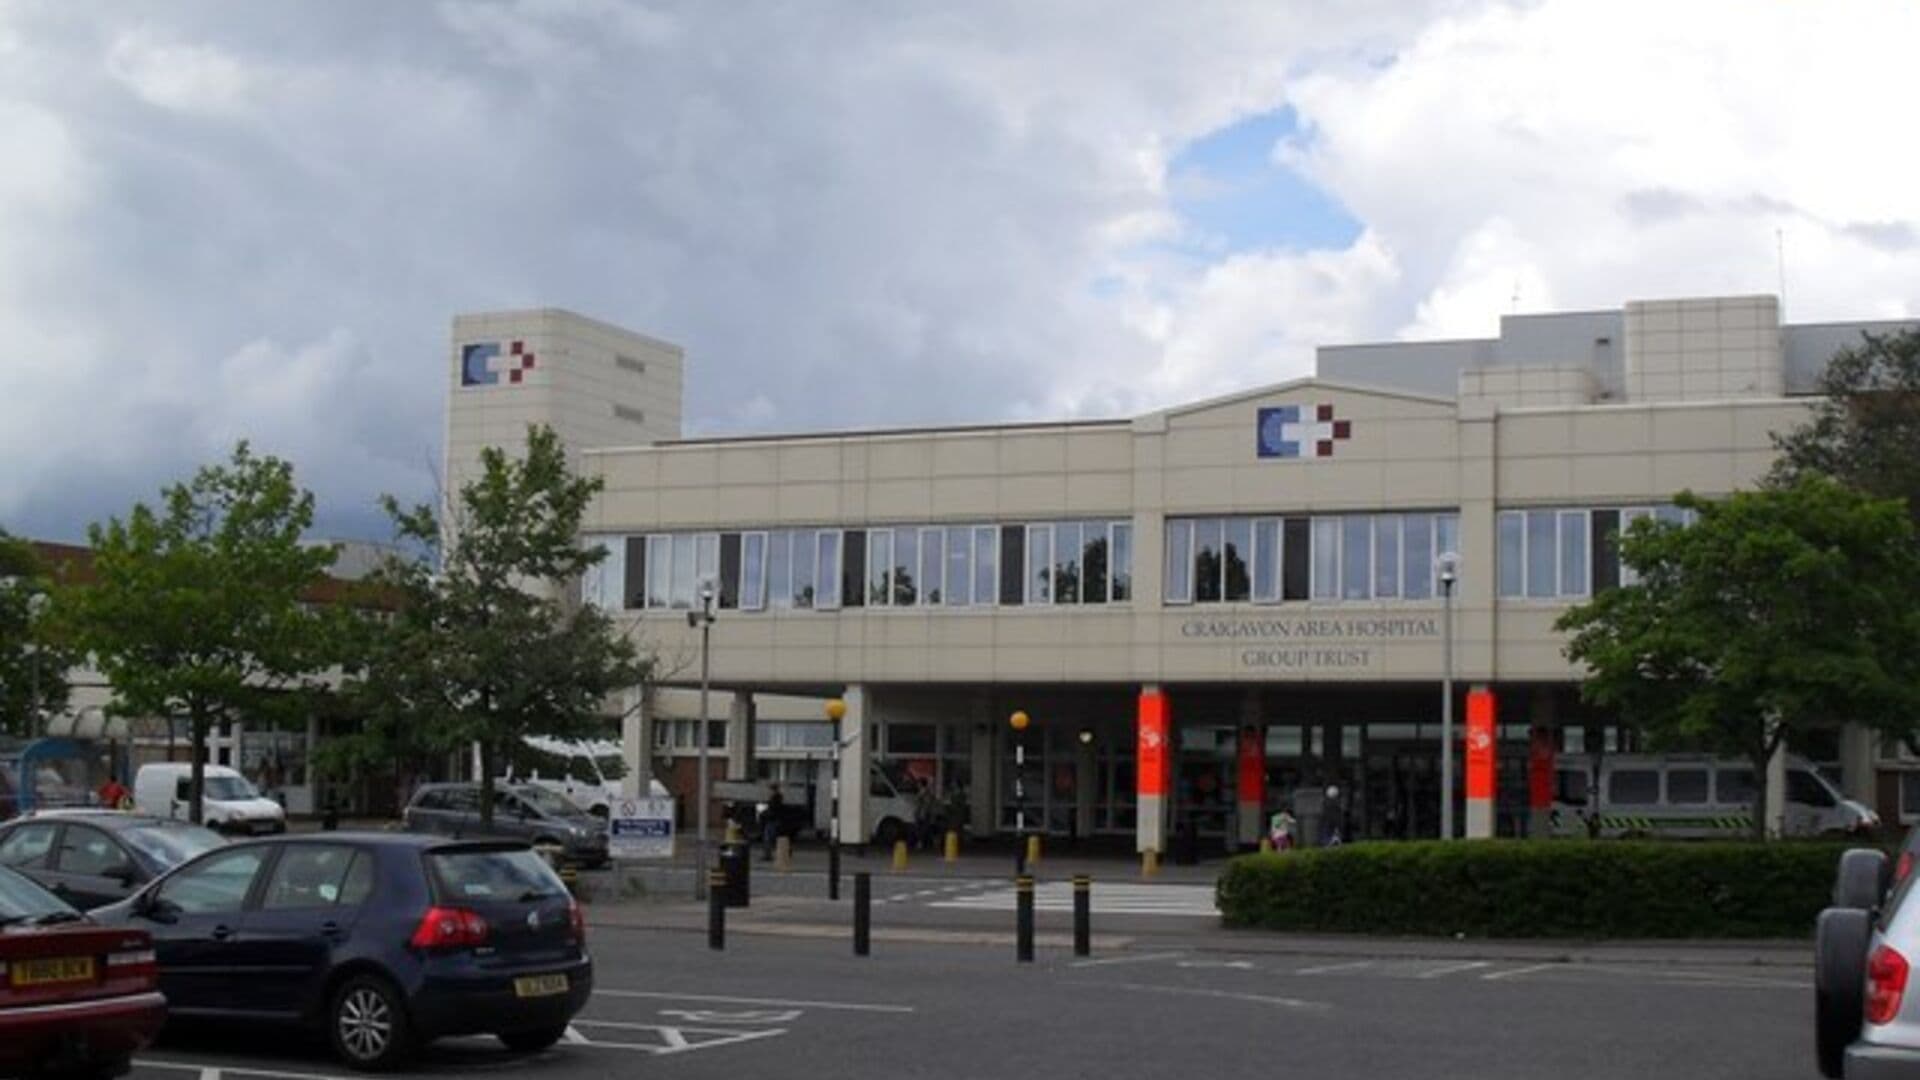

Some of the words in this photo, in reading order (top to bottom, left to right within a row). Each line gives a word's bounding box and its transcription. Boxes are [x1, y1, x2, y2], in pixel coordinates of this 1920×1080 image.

[1181, 620, 1290, 637] CRAIGAVON
[1295, 620, 1343, 636] AREA
[1347, 618, 1439, 636] HOSPITAL
[1241, 650, 1308, 667] GROUP
[1310, 650, 1370, 666] TRUST
